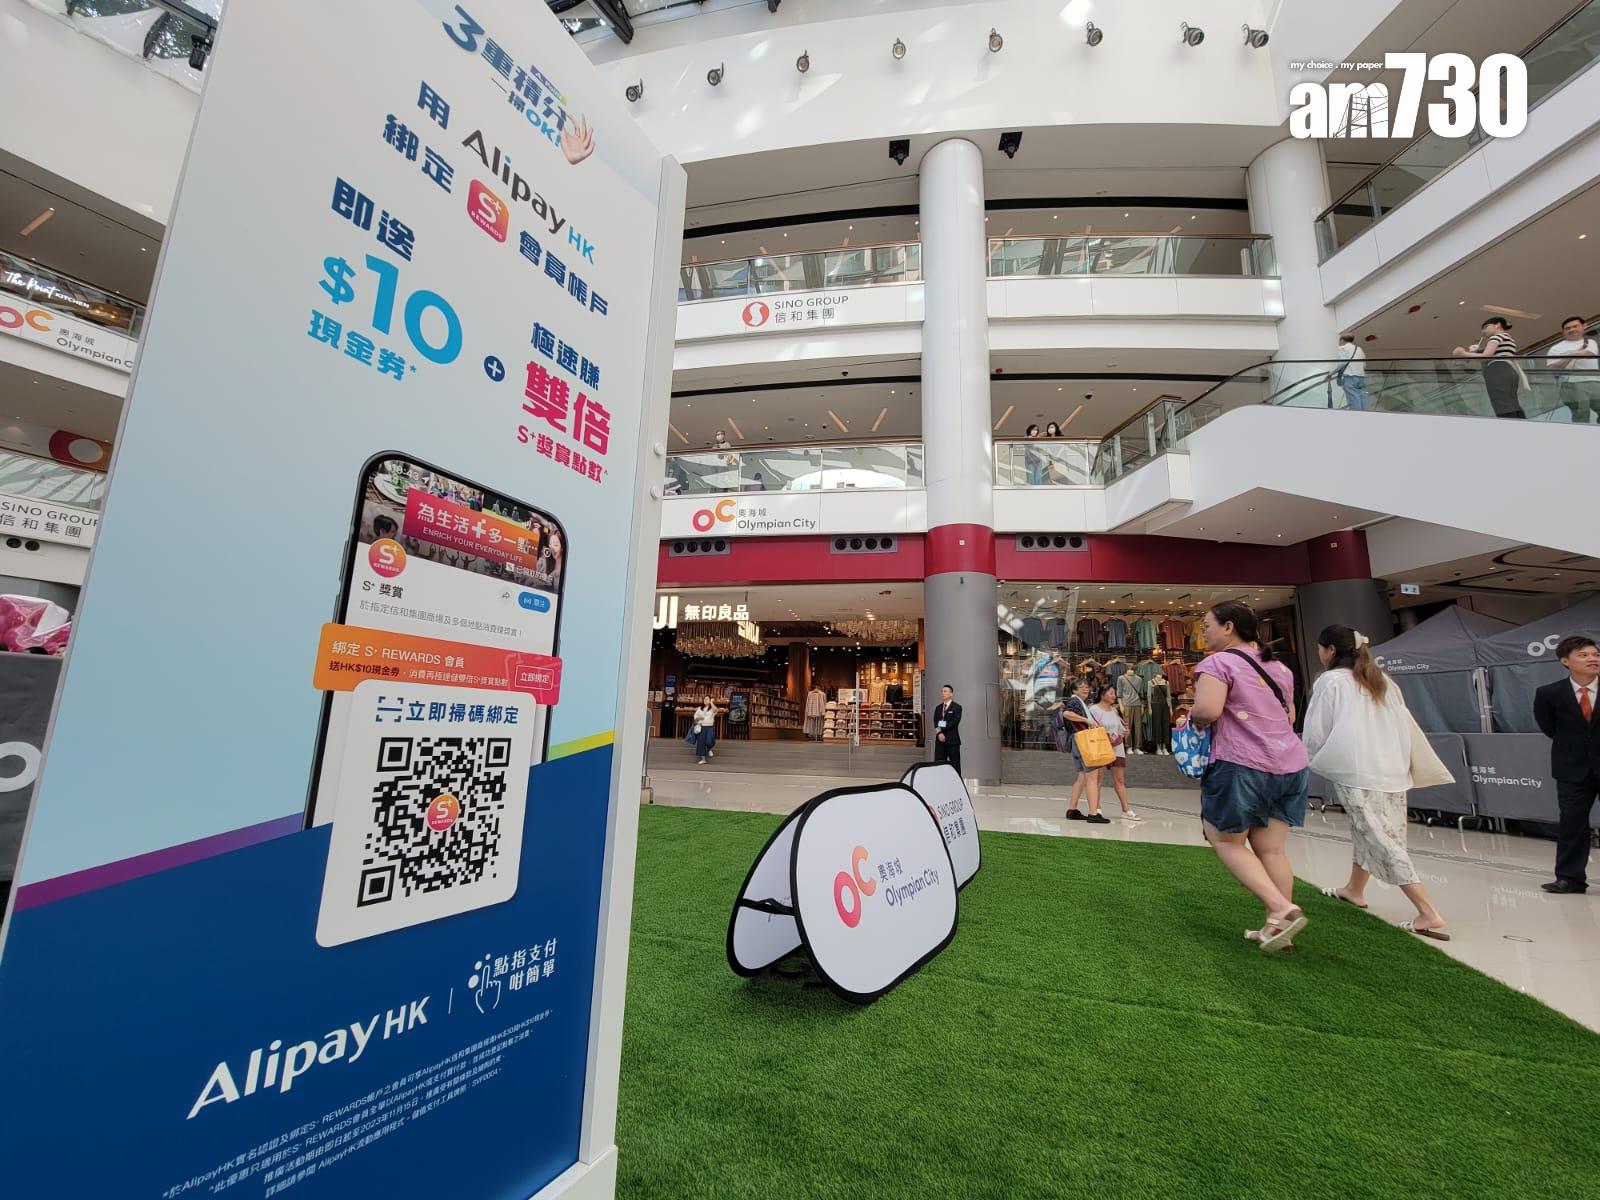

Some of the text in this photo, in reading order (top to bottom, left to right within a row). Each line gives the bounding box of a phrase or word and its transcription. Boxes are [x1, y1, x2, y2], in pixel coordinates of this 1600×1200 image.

[417, 80, 450, 130] 用
[462, 129, 595, 265] AlipayHK
[331, 176, 415, 262] 即送
[383, 113, 454, 194] 綁定
[519, 230, 608, 316] 會員帳戶
[4, 271, 26, 287] The
[27, 277, 60, 299] Point
[319, 253, 463, 365] $10
[775, 295, 849, 310] SINO GROUP
[775, 308, 835, 324] 信和集團
[56, 337, 122, 364] Olympian
[531, 322, 600, 390] 極速賺
[522, 361, 611, 456] 雙倍
[1, 501, 42, 516] SINO
[0, 514, 82, 538] 信和集團
[738, 518, 816, 531] Olympian City
[423, 527, 523, 563] ENRICH YOUR EVERYDAY LIFE
[379, 583, 404, 599] 獎賞
[684, 604, 750, 621] 無印良品
[331, 640, 361, 657] 綁定
[382, 648, 441, 665] REWARDS
[444, 655, 465, 669] 會員
[405, 700, 519, 724] 立即掃碼綁定
[1472, 775, 1542, 788] Olympian City
[885, 868, 940, 907] Olympian City
[493, 937, 558, 977] 點指支付
[509, 957, 556, 992] 咁簡單
[186, 995, 430, 1120] AlipayHK
